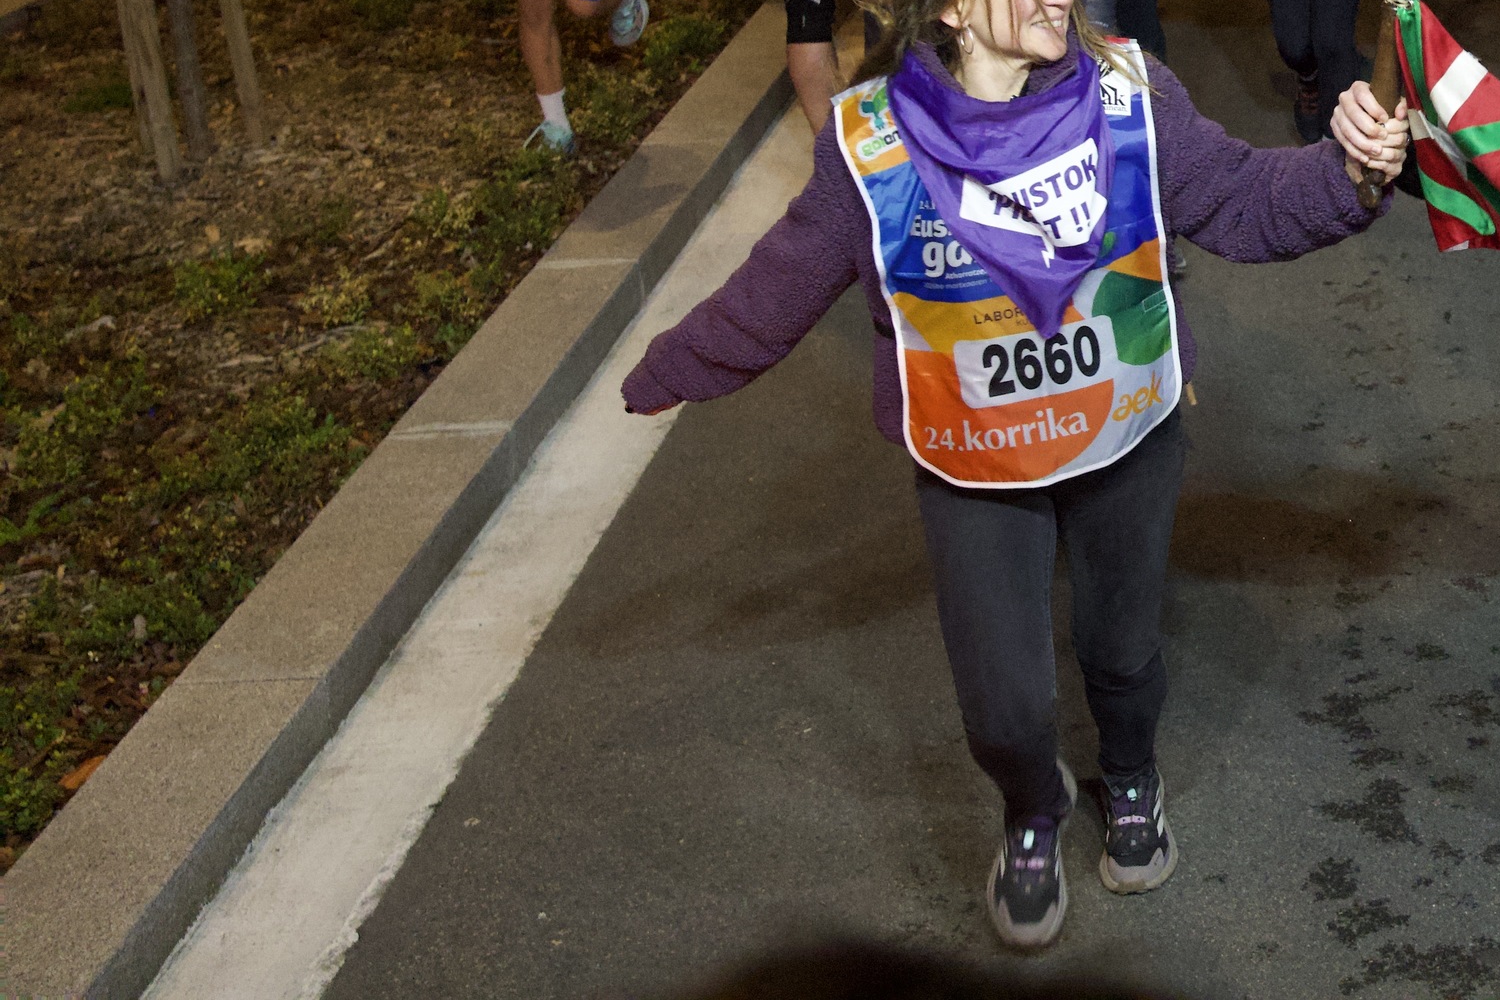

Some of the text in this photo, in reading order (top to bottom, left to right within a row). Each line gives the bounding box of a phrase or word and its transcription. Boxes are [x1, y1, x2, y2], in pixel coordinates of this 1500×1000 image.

[911, 214, 953, 238] Eus
[922, 240, 977, 278] ga
[982, 325, 1101, 398] 2660
[1112, 370, 1164, 422] aek
[924, 407, 1089, 452] 24.korrika
